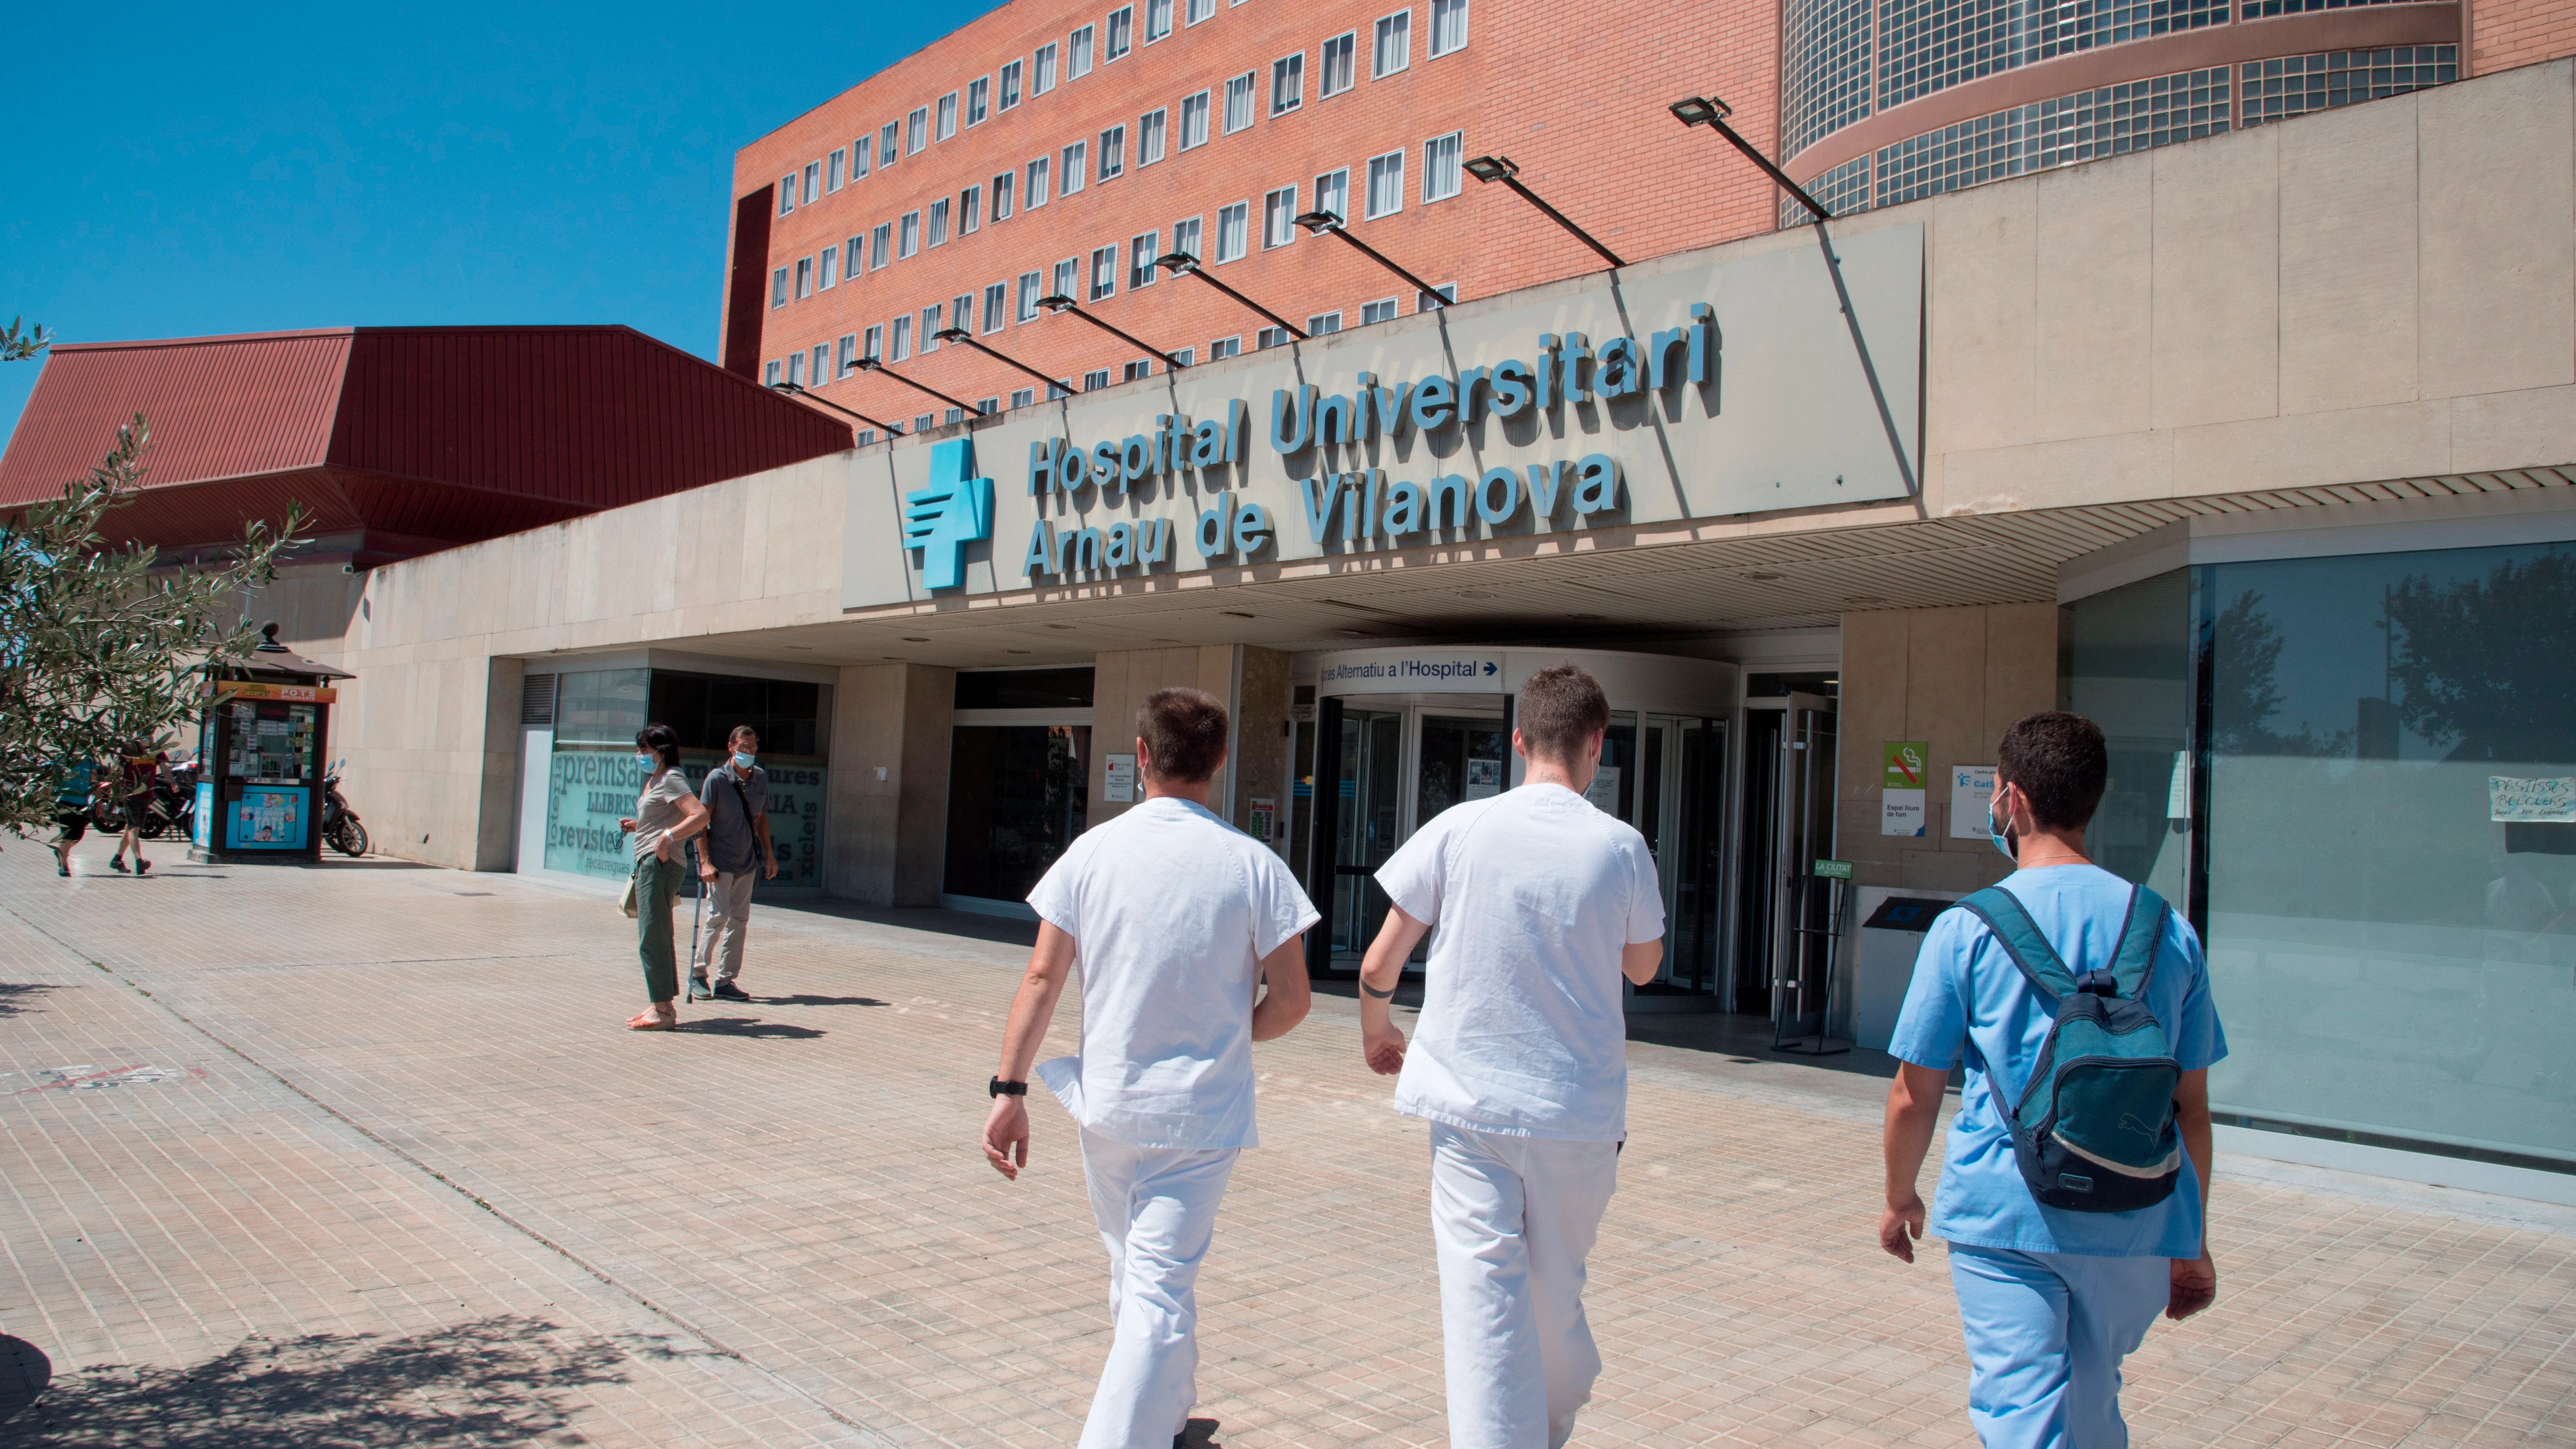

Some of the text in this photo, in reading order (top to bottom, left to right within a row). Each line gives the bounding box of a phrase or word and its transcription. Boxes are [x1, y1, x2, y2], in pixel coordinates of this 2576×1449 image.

[1029, 302, 1712, 497] Hospital Universitari
[1023, 453, 1622, 577] Arnau de Vilanova
[1336, 662, 1384, 679] Alternatiu
[1388, 665, 1396, 677] a
[561, 755, 640, 795] premsa
[548, 755, 562, 849] loteria
[587, 791, 638, 816] LLIBRES
[559, 819, 623, 855] revistes
[797, 802, 817, 878] xiclets
[1827, 863, 1852, 872] CIUTAT
